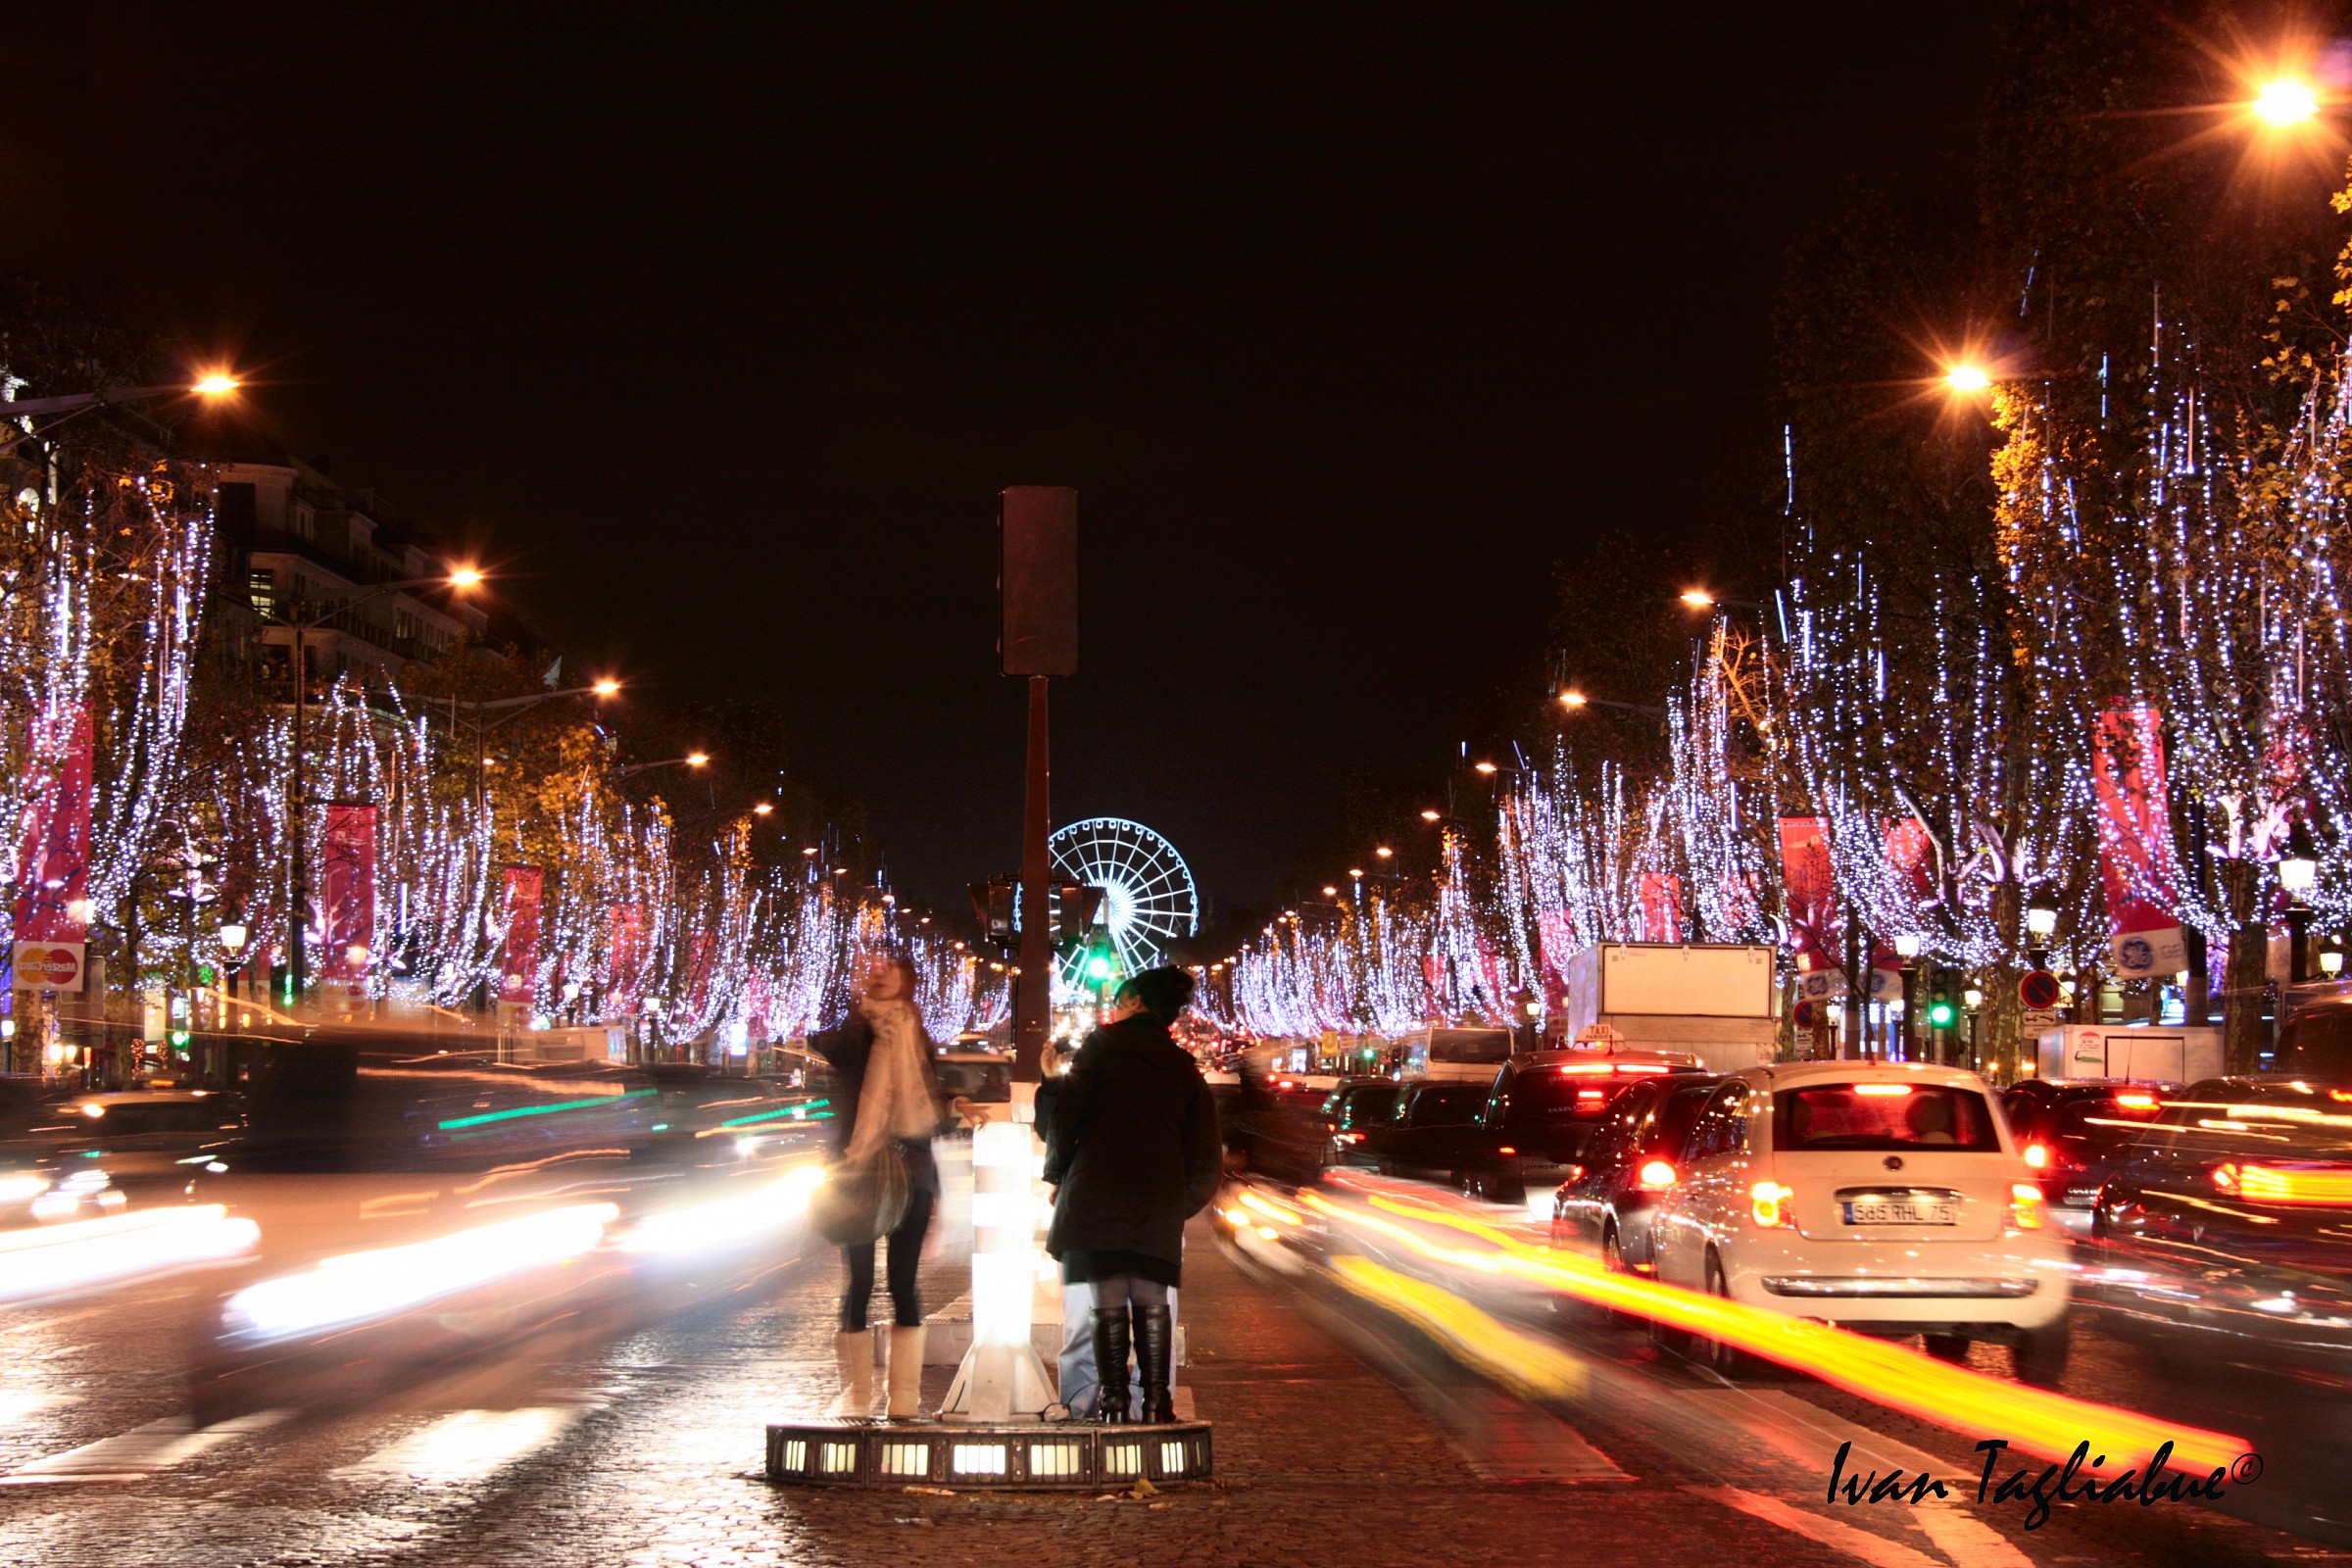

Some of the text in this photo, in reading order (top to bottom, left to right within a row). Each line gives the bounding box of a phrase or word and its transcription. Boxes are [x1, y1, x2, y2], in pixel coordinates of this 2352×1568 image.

[1590, 1025, 1609, 1035] TAXI
[1854, 1204, 1886, 1221] 585
[1891, 1204, 1923, 1221] RHL
